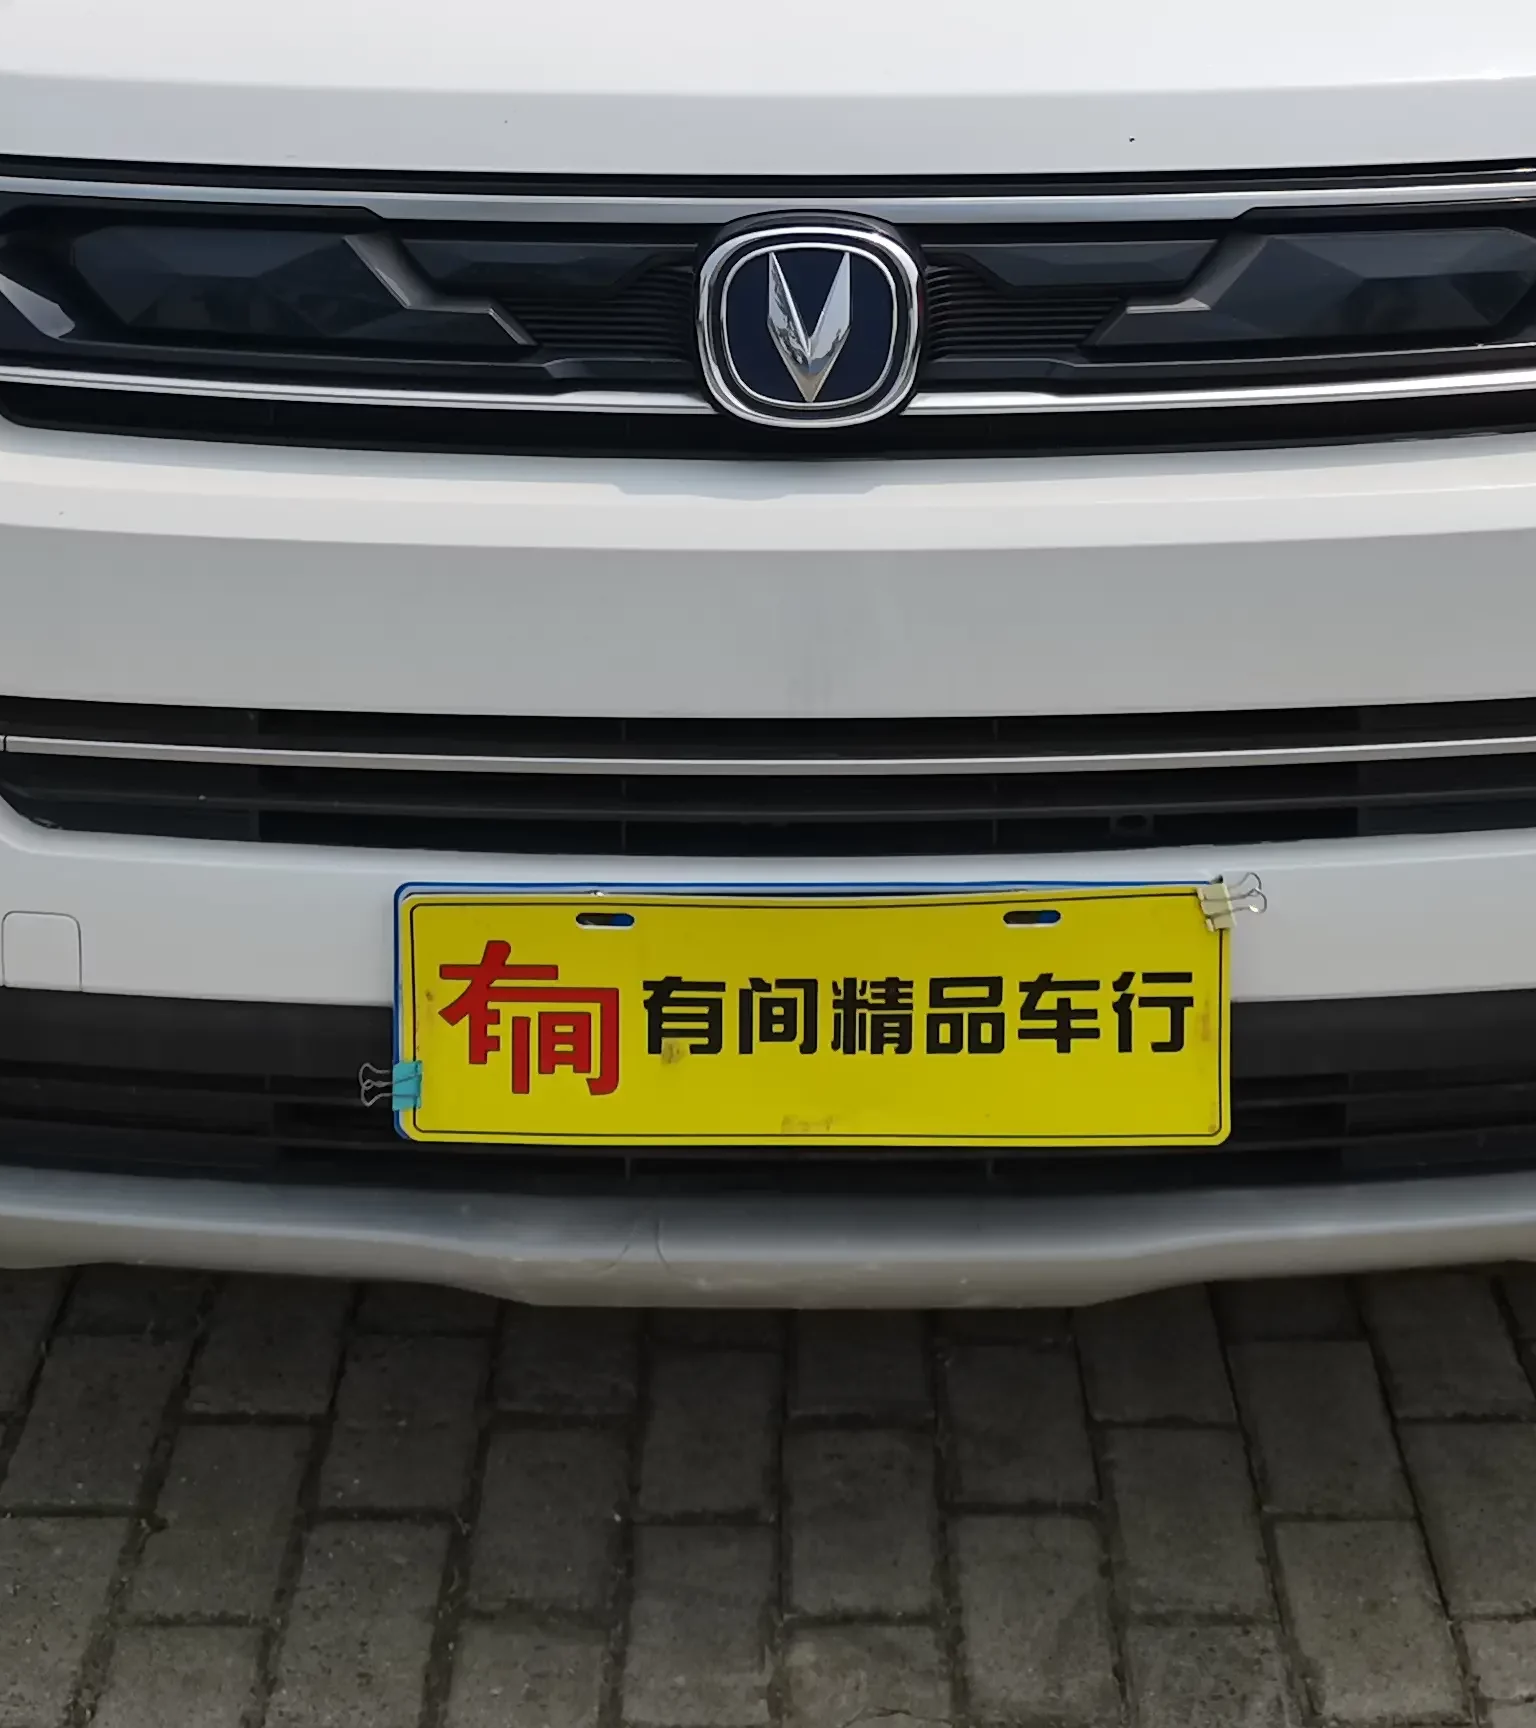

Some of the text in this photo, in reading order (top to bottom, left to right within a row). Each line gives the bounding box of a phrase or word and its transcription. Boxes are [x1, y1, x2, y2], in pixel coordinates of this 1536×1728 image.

[642, 971, 1194, 1055] 有间精品车行
